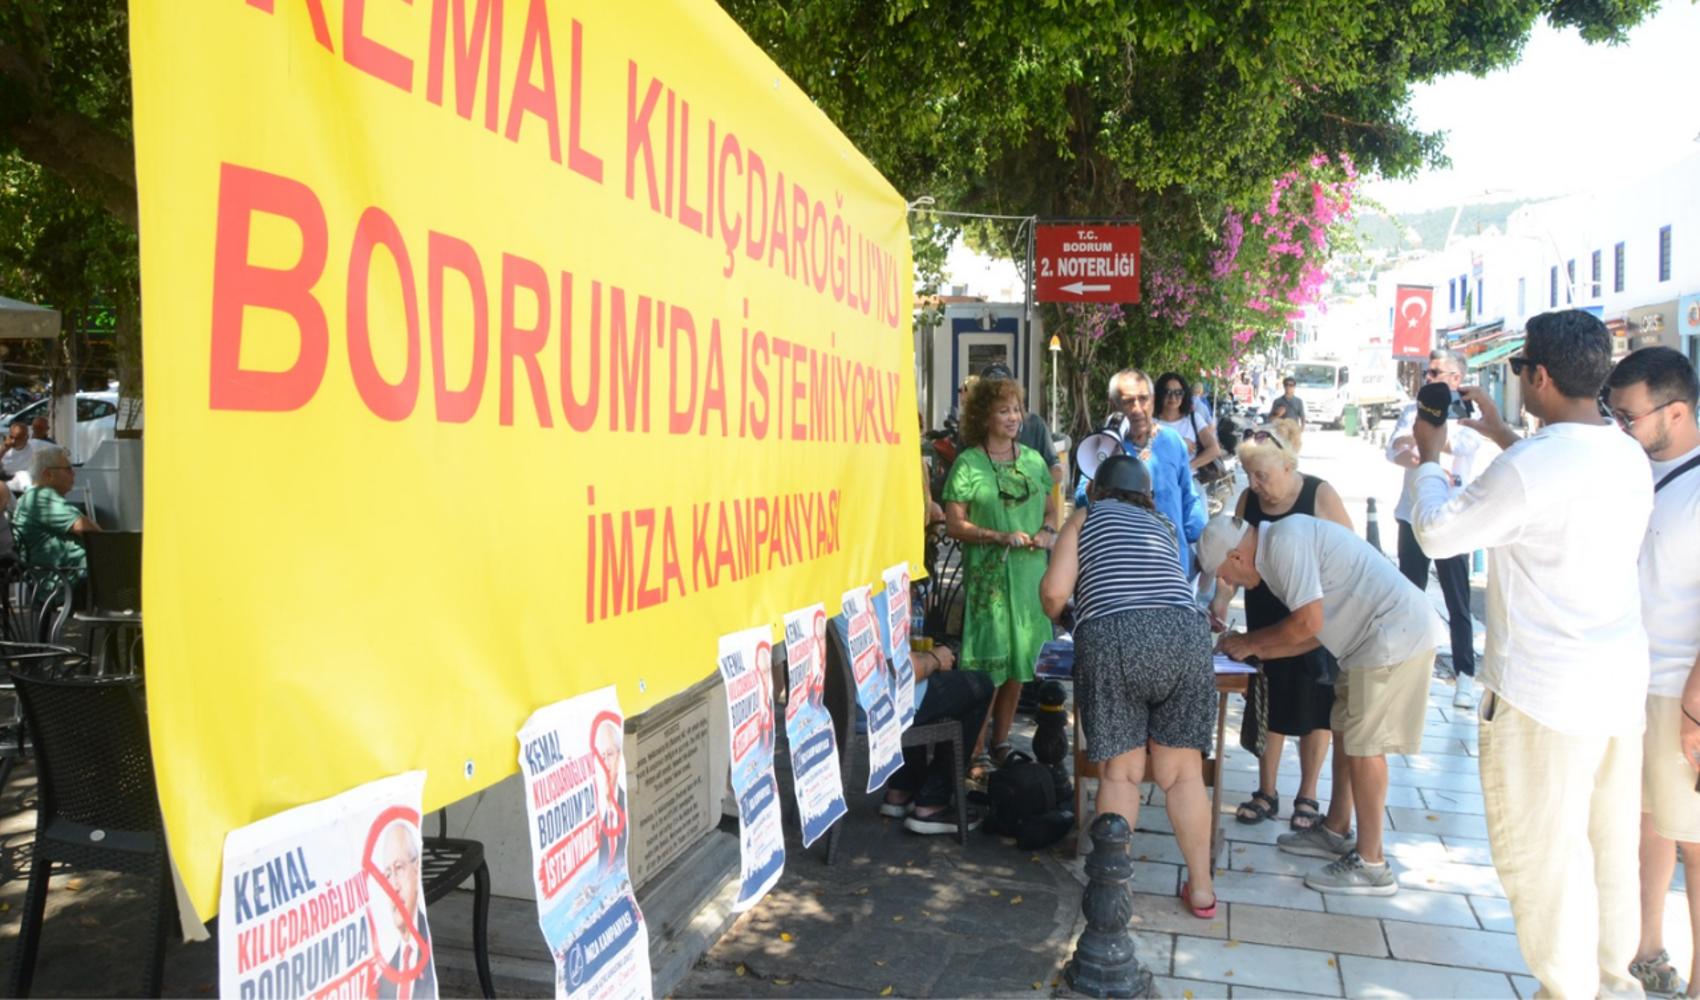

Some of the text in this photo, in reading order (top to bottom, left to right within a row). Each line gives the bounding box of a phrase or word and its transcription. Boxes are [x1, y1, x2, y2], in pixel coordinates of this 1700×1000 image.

[625, 58, 899, 328] KILIÇDAROĞLU'NU
[1041, 253, 1134, 277] 2. NOTERLİĞİ
[1063, 242, 1113, 252] BODRUM
[1077, 230, 1098, 240] T.C.
[209, 162, 901, 445] BODRUM'DA İSTEMİYORUZ
[586, 485, 841, 624] İMZA KAMPANYASI
[525, 729, 564, 776] KEMAL
[234, 847, 316, 925] KEMAL
